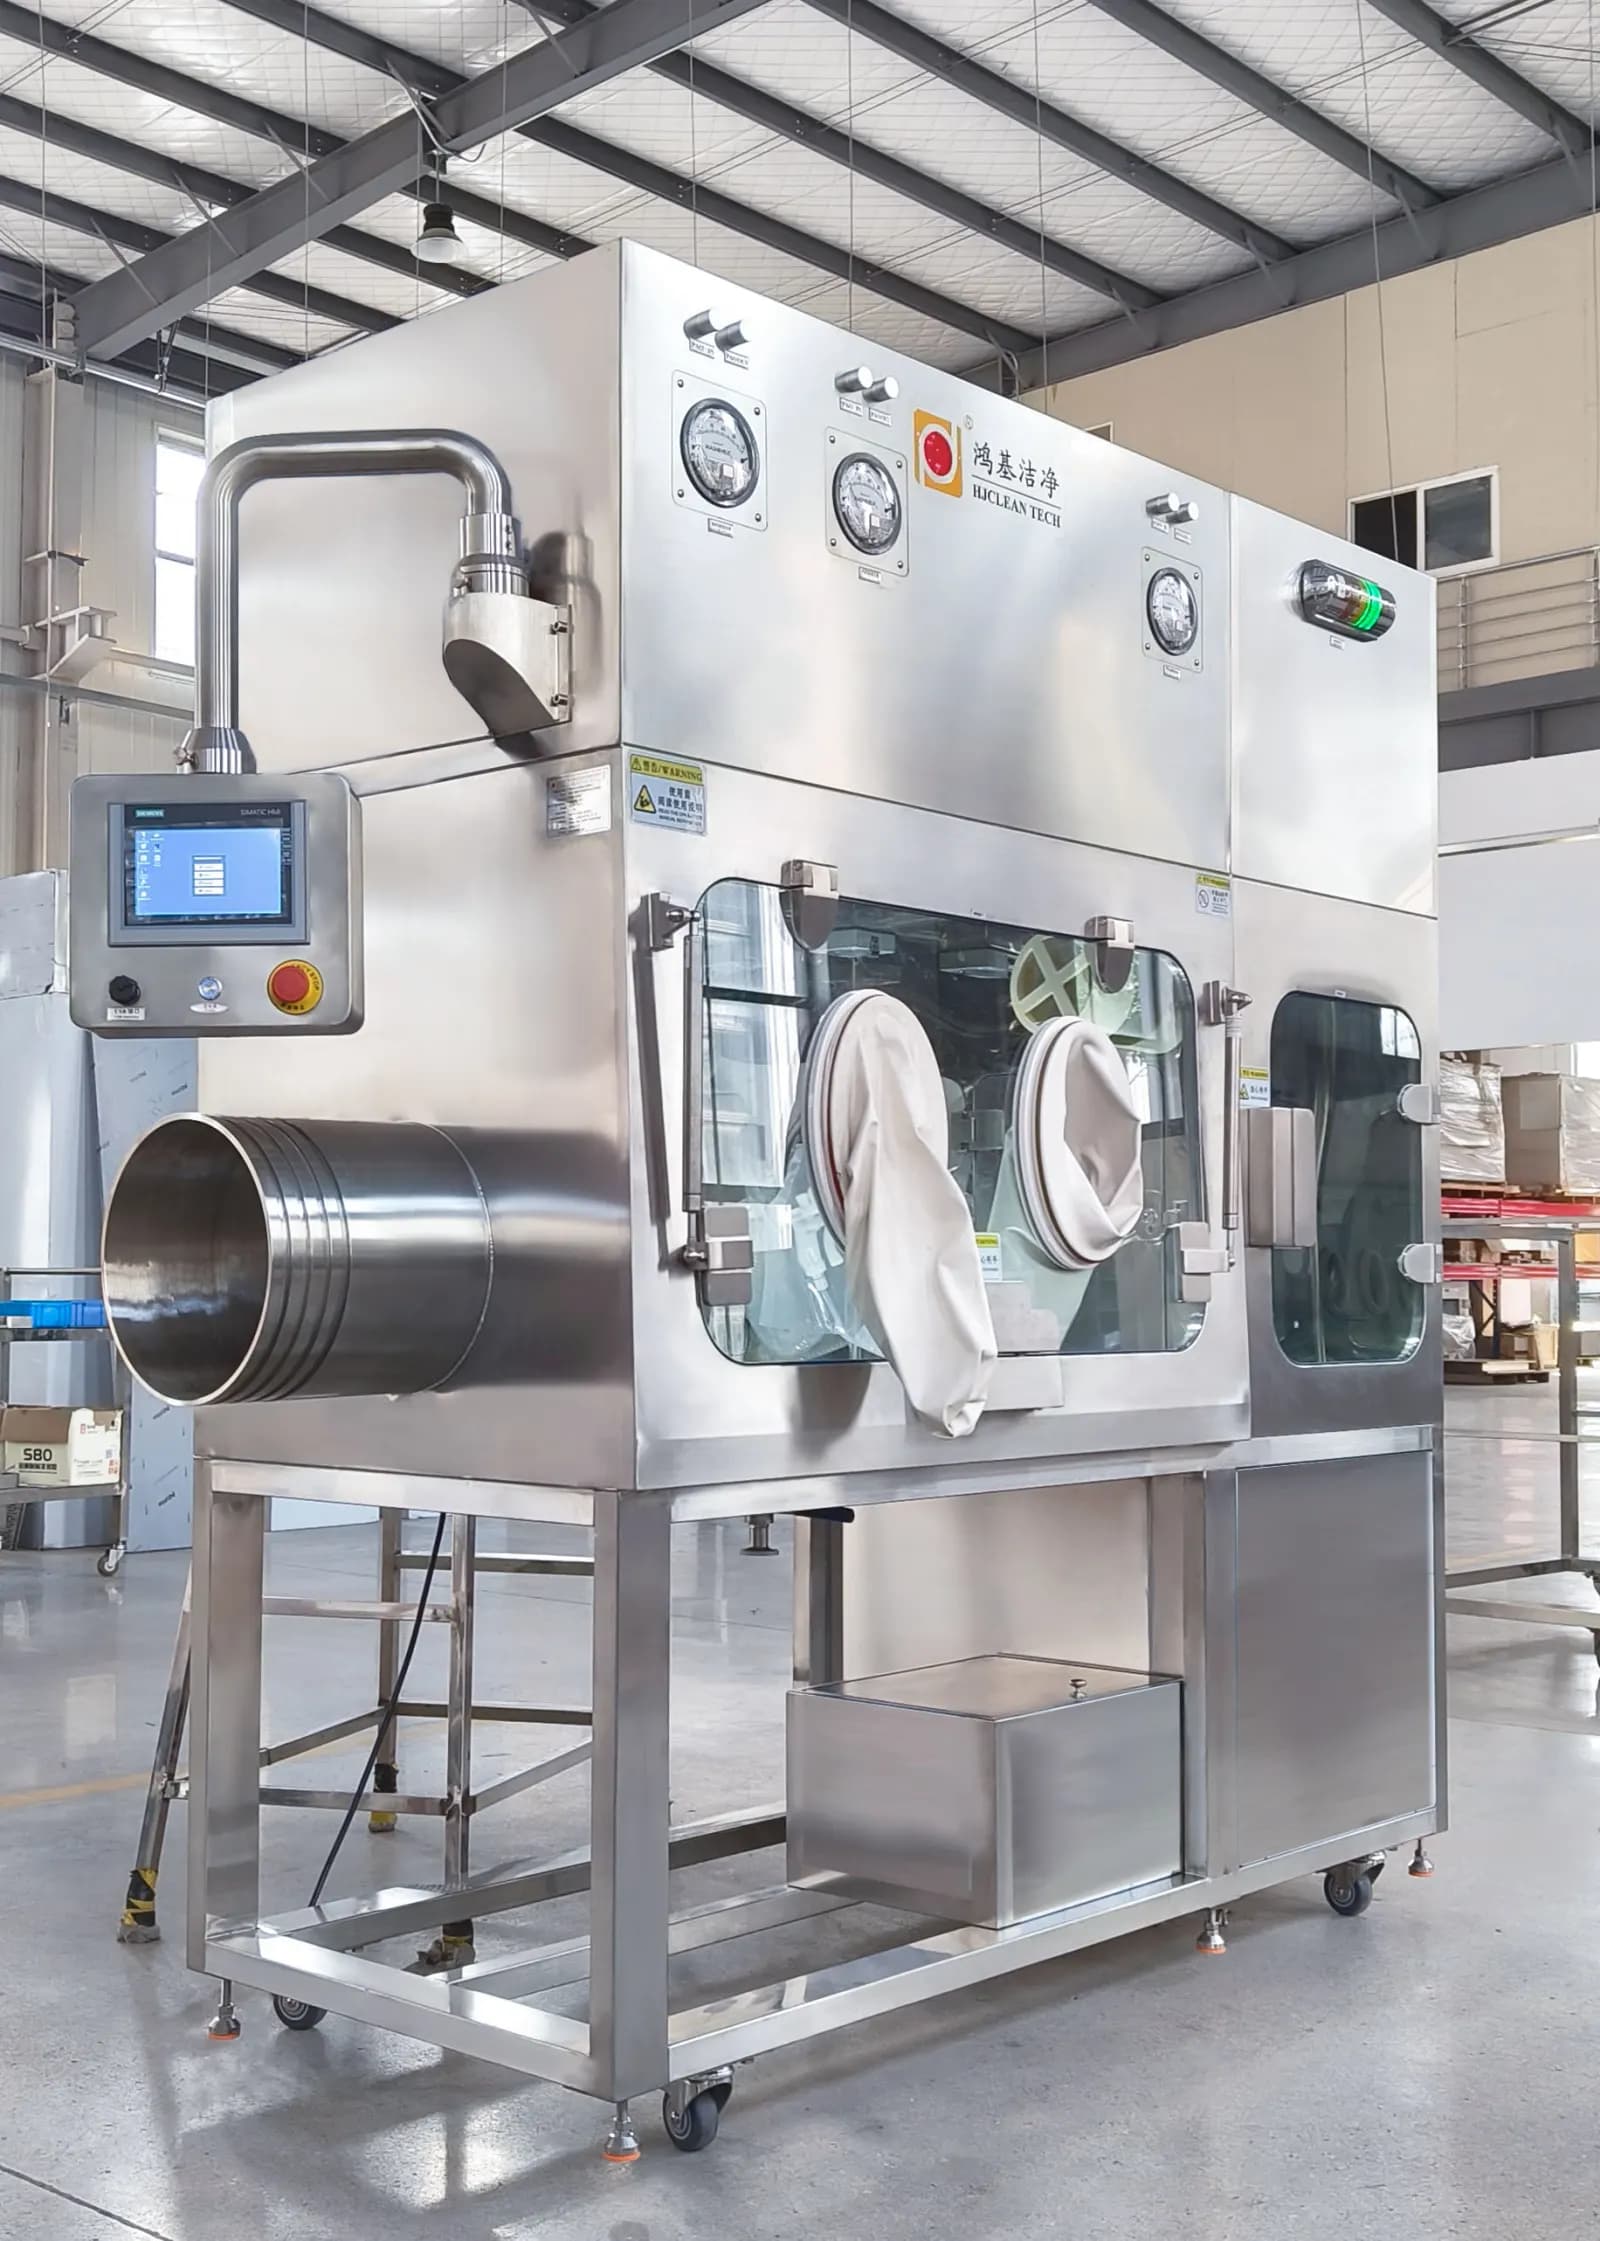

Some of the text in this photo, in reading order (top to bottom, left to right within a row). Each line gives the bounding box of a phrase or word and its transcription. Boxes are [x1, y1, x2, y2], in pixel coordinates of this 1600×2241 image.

[972, 441, 1060, 499] 鸿基洁净
[972, 484, 1061, 528] HJCLEAN TECH
[240, 808, 267, 816] SIMATIC
